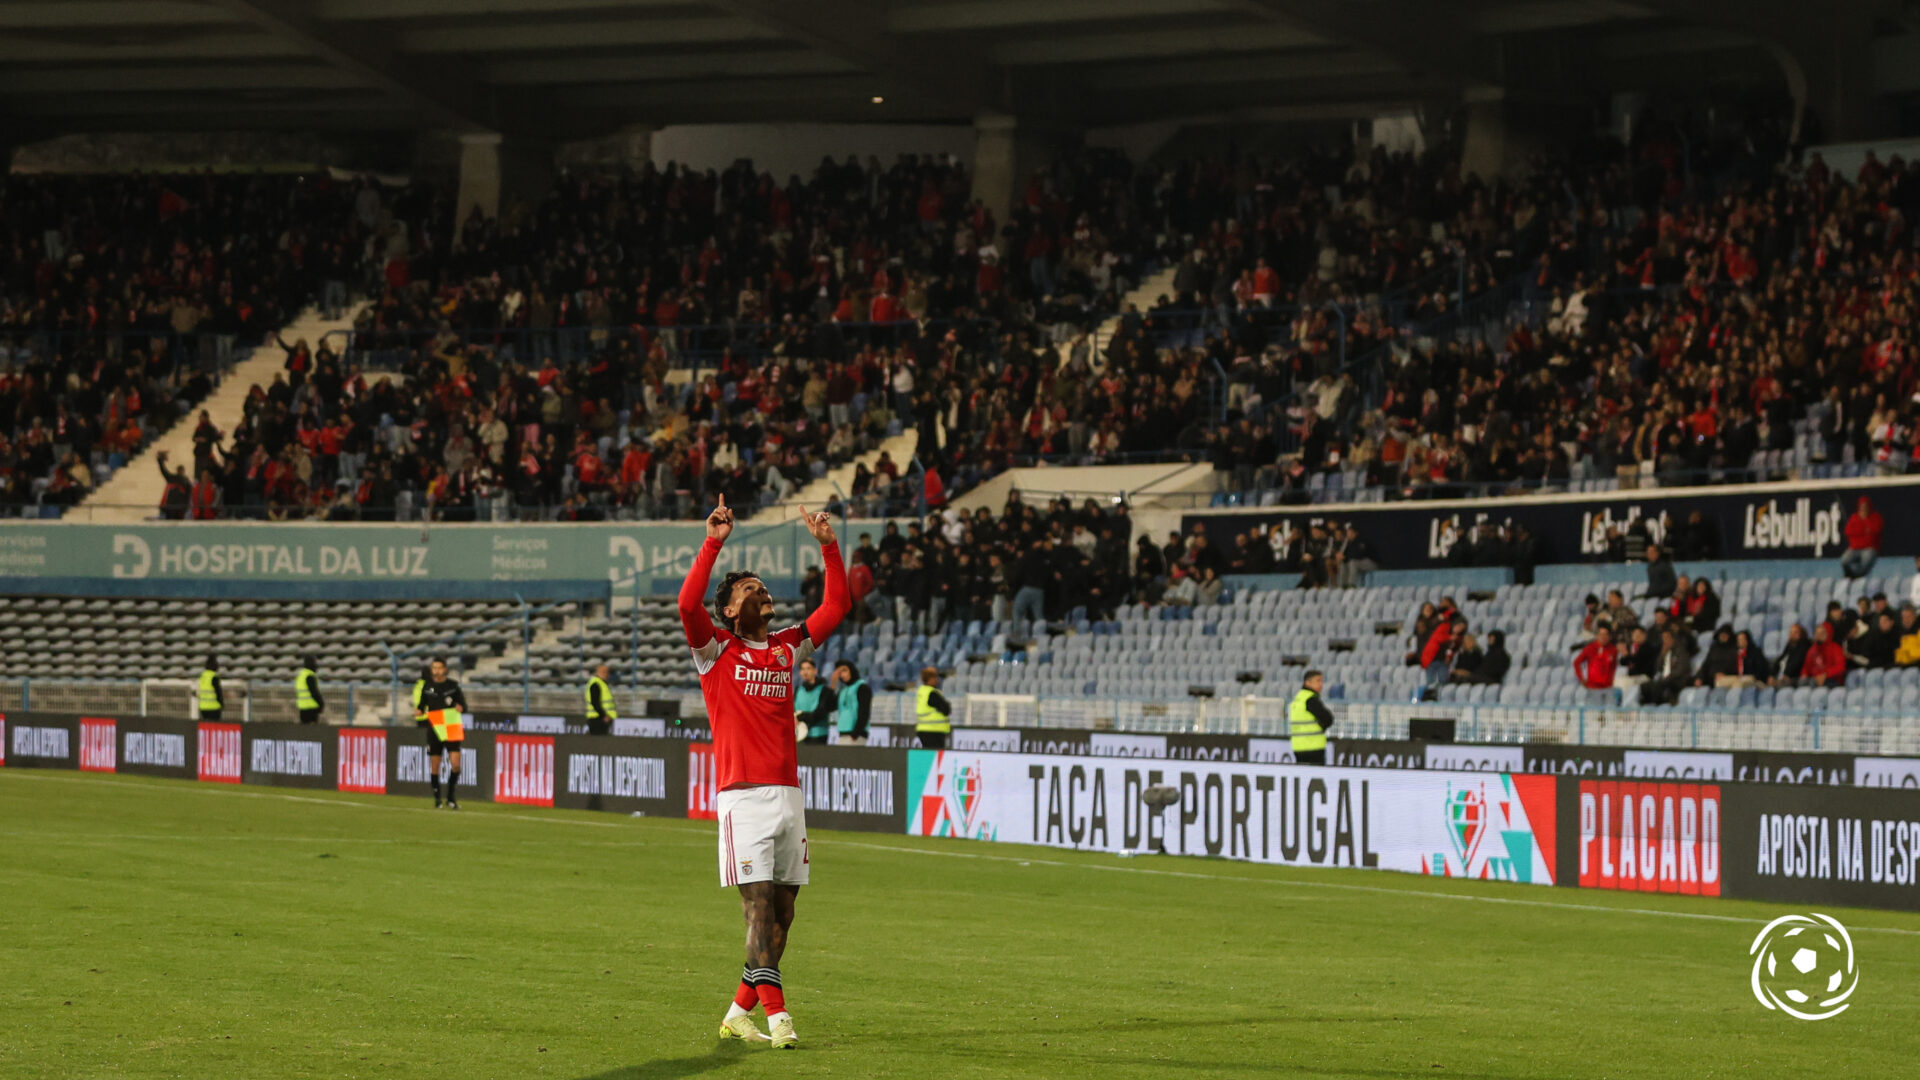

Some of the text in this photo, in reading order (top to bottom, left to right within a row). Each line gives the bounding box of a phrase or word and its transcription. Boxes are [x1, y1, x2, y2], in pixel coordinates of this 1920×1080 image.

[1743, 498, 1841, 557] Lebull.pt
[159, 544, 429, 575] HOSPITAL DA LUZ
[652, 545, 792, 575] HOPITAL
[735, 664, 791, 684] Emirates
[744, 682, 787, 698] FLY BETTER
[338, 735, 386, 787] PLACARD
[495, 741, 554, 799] PLACARD
[568, 753, 599, 793] APOSTA
[601, 755, 613, 795] NA
[614, 755, 665, 799] DESPORTIVA
[815, 766, 829, 810] NA
[831, 767, 894, 815] DESPORTIVA
[1124, 769, 1163, 850] DE
[1180, 771, 1379, 867] PORTUGAL
[1580, 792, 1718, 884] PLACARD
[1757, 813, 1920, 886] APOSTA NA DESP
